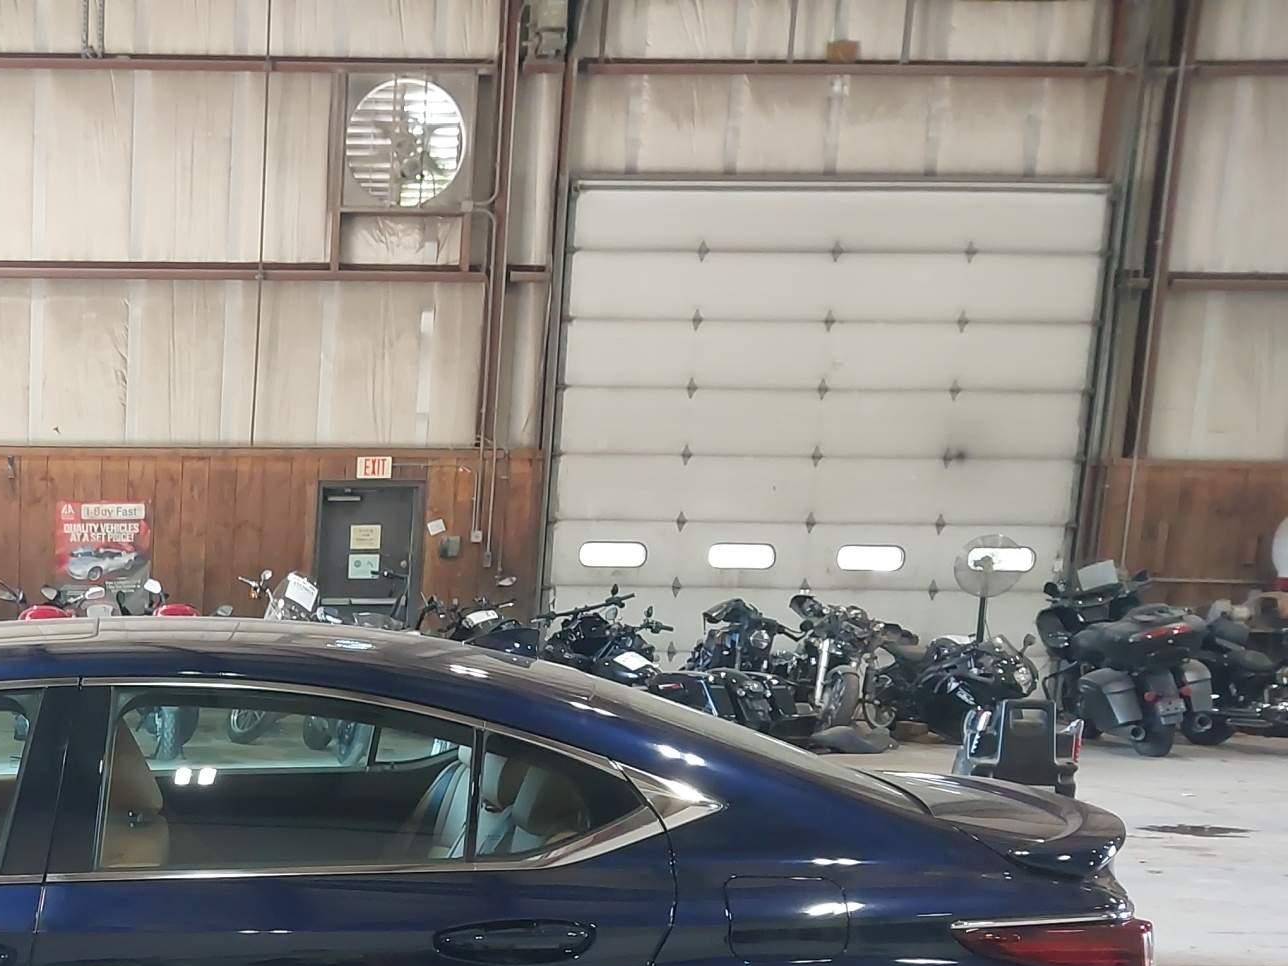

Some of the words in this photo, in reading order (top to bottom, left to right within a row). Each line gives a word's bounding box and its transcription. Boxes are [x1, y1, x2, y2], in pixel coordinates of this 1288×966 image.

[364, 458, 387, 476] EXIT
[116, 506, 137, 515] Fast
[64, 523, 99, 533] QUALITY
[99, 523, 140, 533] VEHICLES
[70, 533, 81, 543] AT
[81, 533, 89, 543] A
[91, 533, 105, 543] SET
[107, 533, 135, 543] PRICE!
